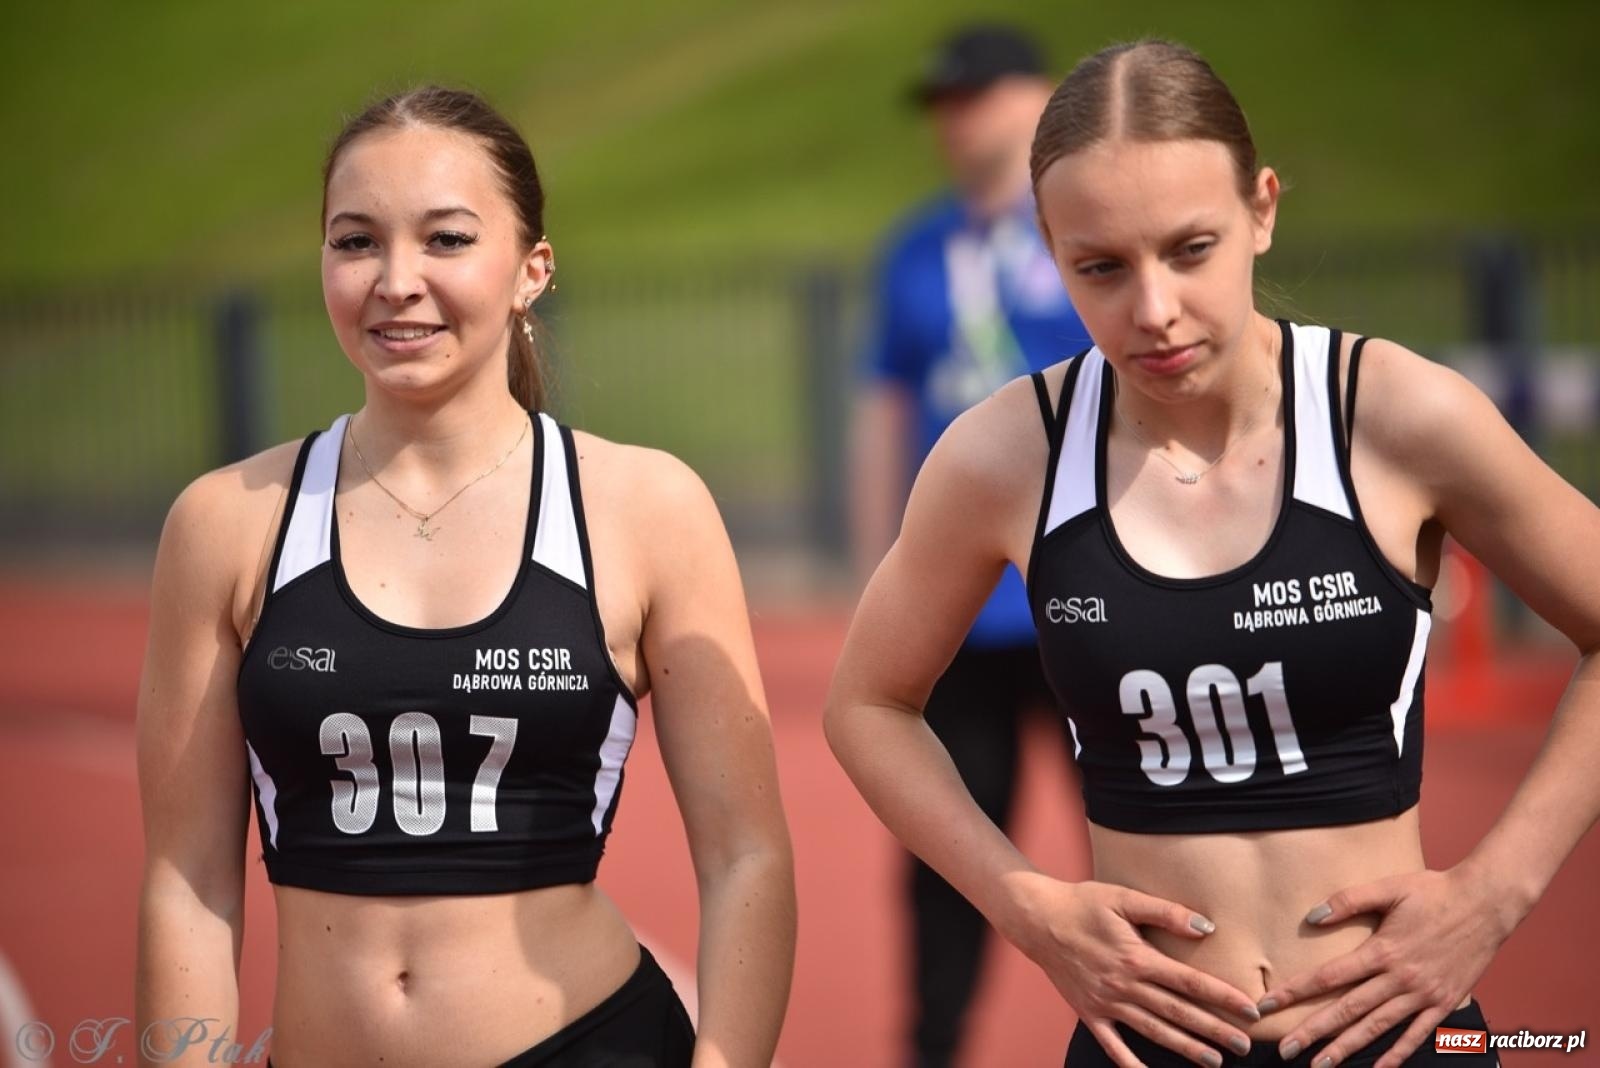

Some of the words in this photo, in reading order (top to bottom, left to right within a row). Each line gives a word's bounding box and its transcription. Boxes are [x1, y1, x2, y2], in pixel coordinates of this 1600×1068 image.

[1252, 579, 1302, 608] MOS
[1308, 571, 1358, 600] CSIR
[1233, 607, 1309, 633] DĄBROWA
[1314, 596, 1382, 624] GÓRNICZA
[475, 648, 520, 671] MOS
[528, 648, 572, 671] CSIR
[452, 673, 523, 694] DĄBROWA
[527, 671, 590, 692] GÓRNICZA
[1118, 661, 1309, 787] 301
[318, 711, 519, 836] 307
